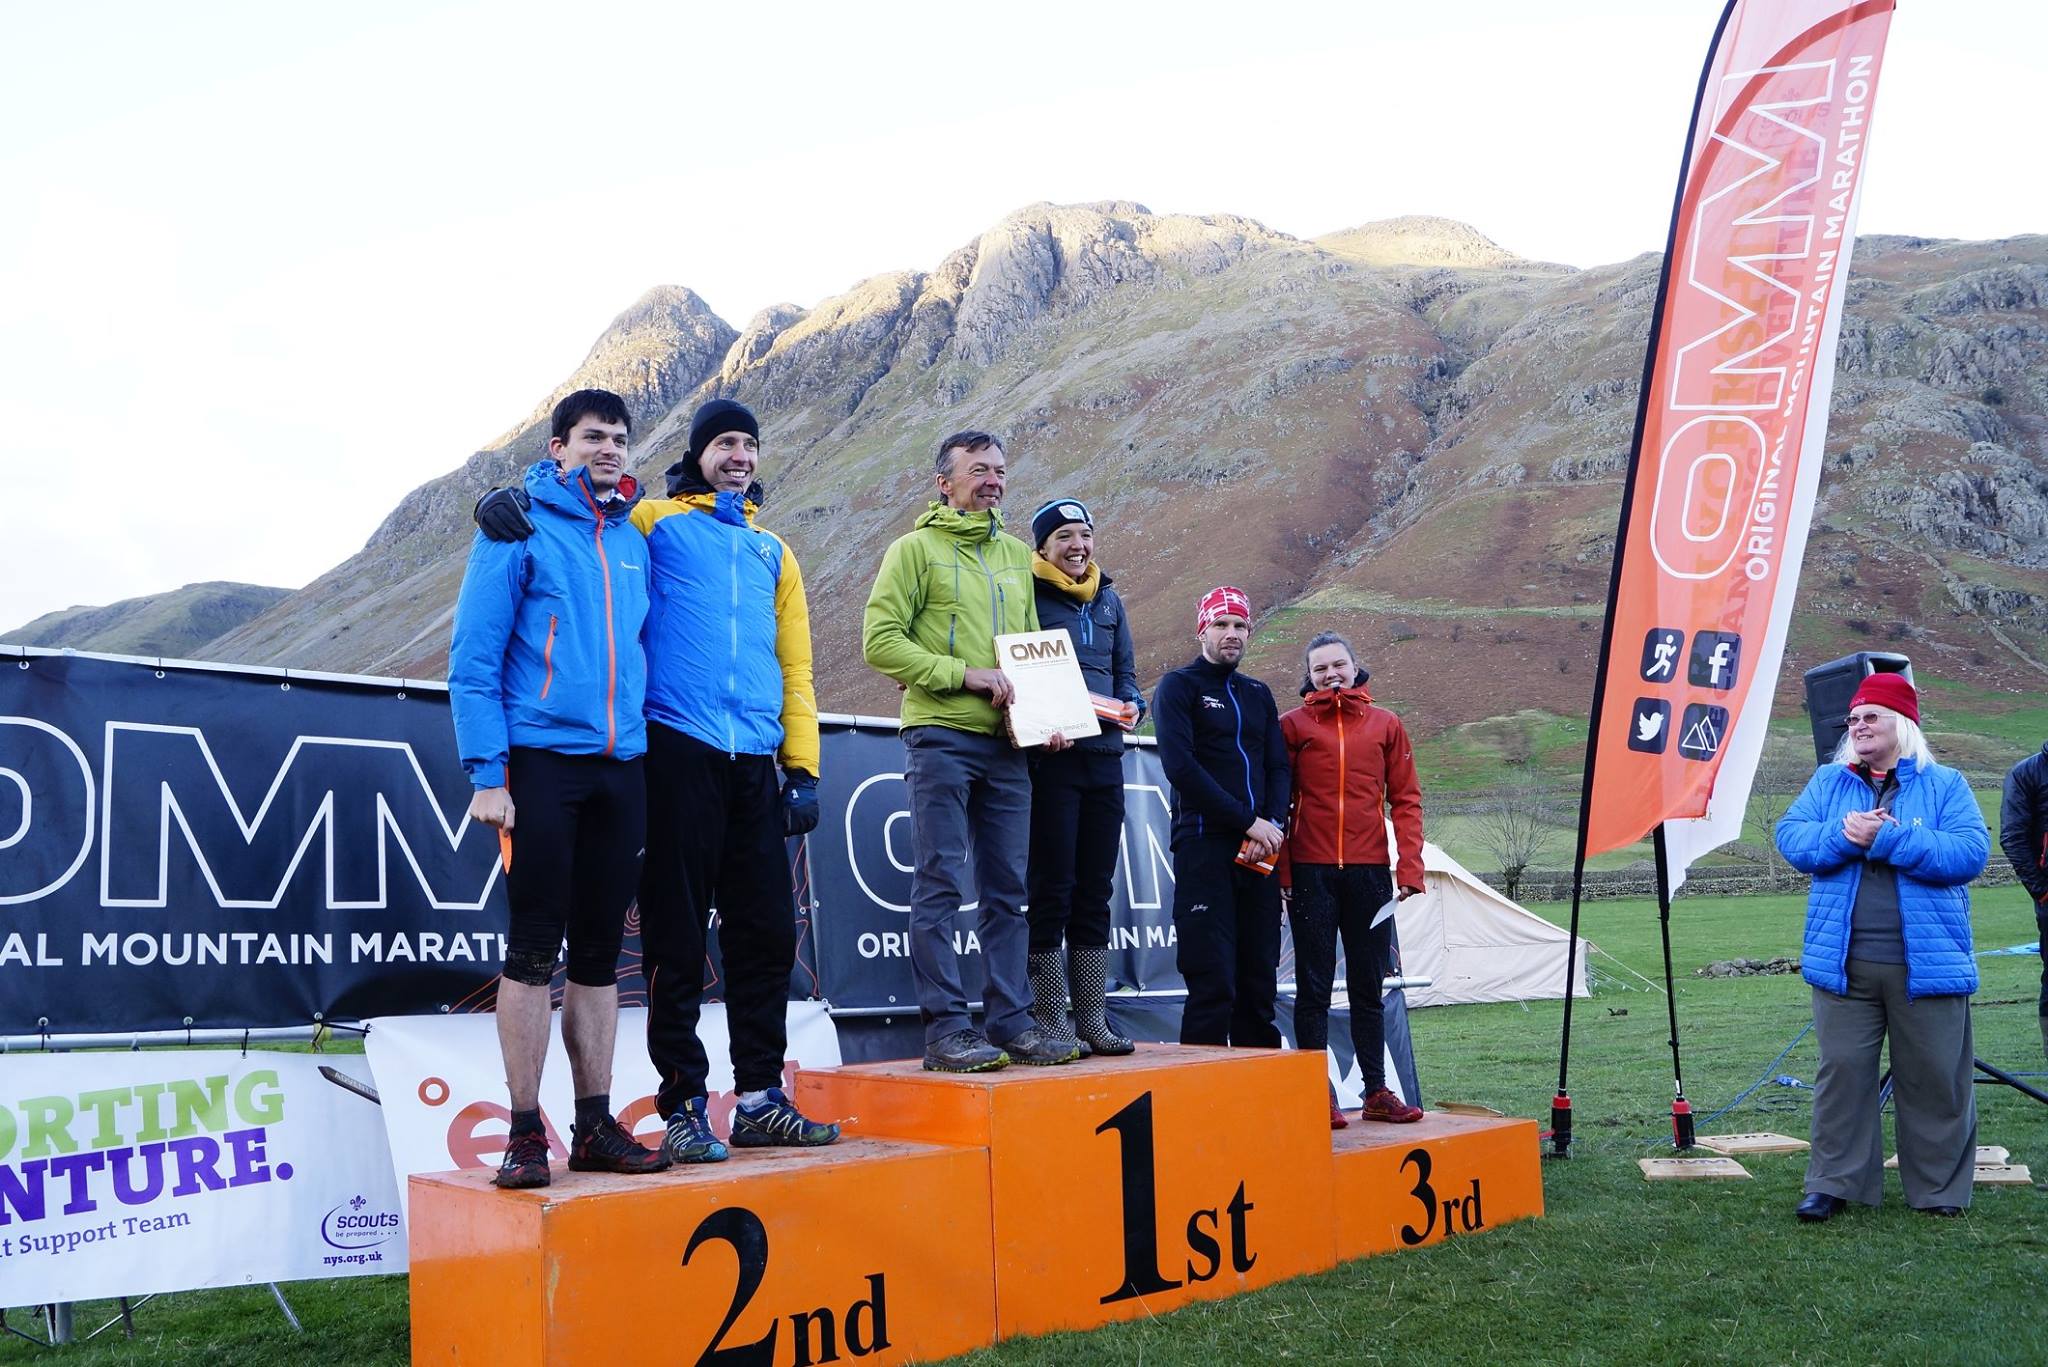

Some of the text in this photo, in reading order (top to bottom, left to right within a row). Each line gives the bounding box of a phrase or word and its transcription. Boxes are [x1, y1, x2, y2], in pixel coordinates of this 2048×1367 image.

[1650, 57, 1837, 580] OMM
[1745, 55, 1873, 581] ORIGINAL MOUNTAIN MARATHON
[1009, 639, 1068, 661] OMM
[82, 933, 334, 966] MOUNTAIN
[19, 1221, 117, 1255] Support
[123, 1212, 190, 1236] Team
[1095, 1090, 1258, 1305] 1st
[1399, 1148, 1485, 1246] 3rd
[323, 1250, 383, 1267] nys.org.uk
[681, 1206, 892, 1367] 2nd
